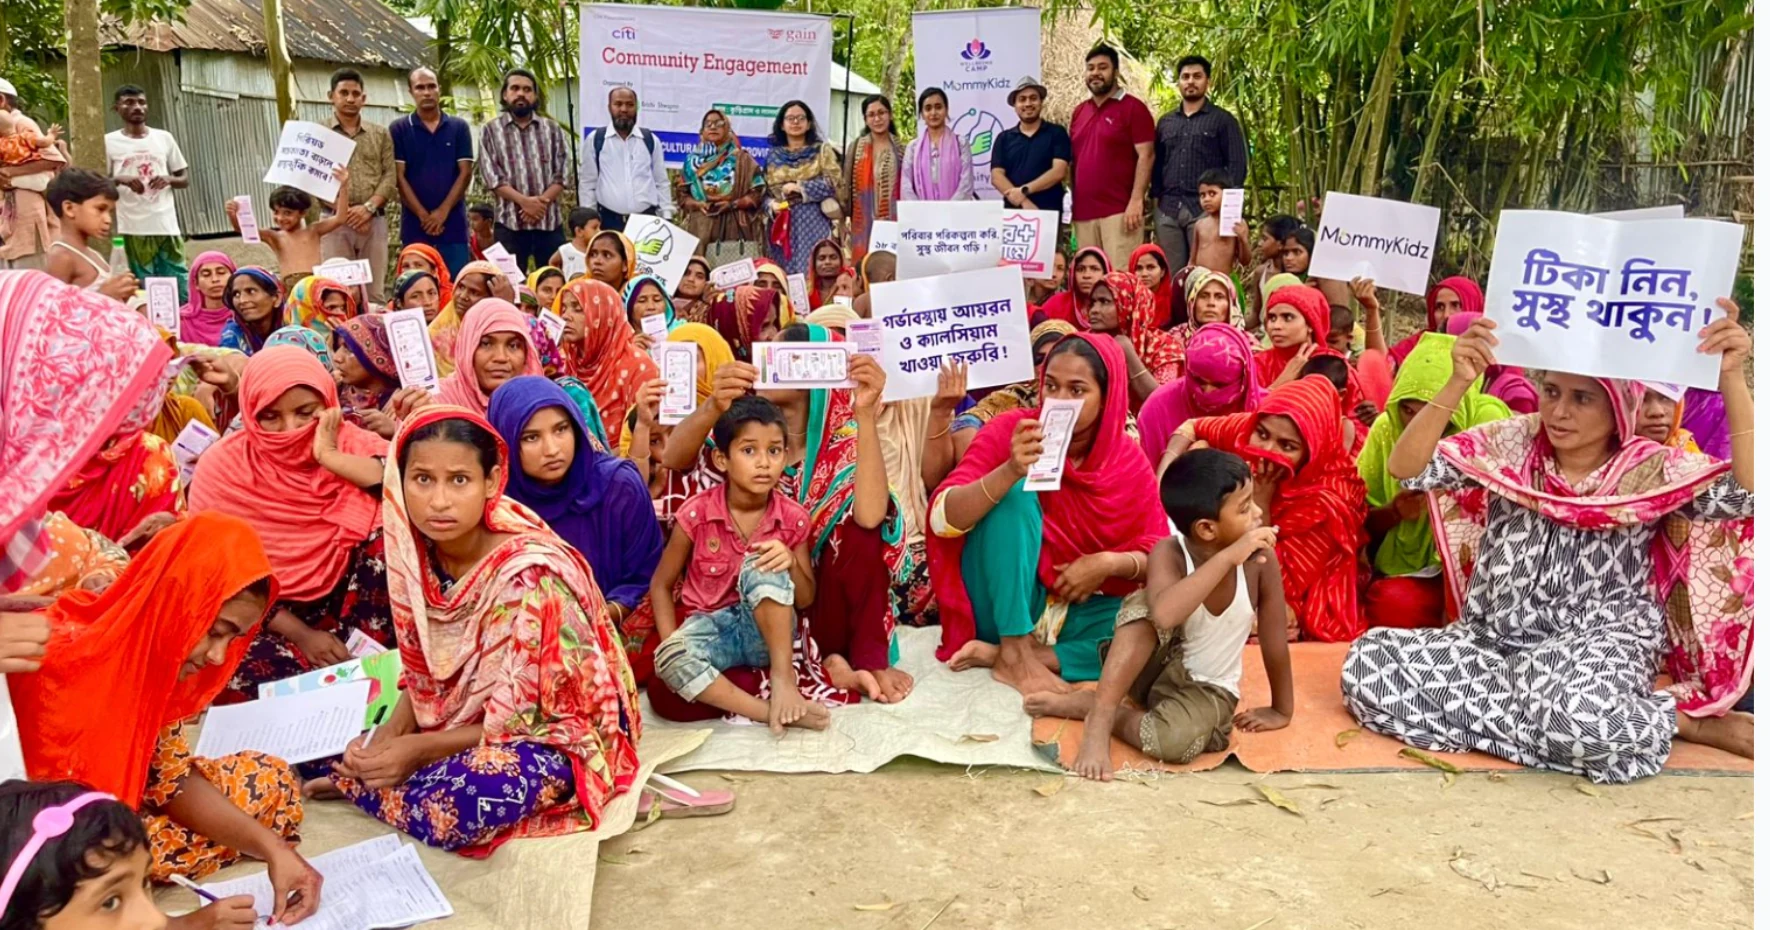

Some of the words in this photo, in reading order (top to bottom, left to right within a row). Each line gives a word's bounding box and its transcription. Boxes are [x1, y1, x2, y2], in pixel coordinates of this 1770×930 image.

[612, 27, 635, 40] citi
[786, 28, 816, 43] gain
[602, 47, 698, 73] Community
[703, 53, 808, 76] Engagement
[943, 77, 1011, 91] MommyKidz
[661, 142, 697, 154] CULTURA
[901, 228, 933, 240] পরিবার
[1320, 226, 1429, 259] MommyKidz
[934, 240, 960, 252] জীবন
[1522, 248, 1610, 295] টিকা
[882, 308, 947, 329] গর্ভাবস্থায়
[951, 299, 1011, 318] আয়রন
[1512, 290, 1576, 332] সুস্থ
[900, 336, 912, 350] ও
[916, 323, 998, 348] ক্যালসিয়াম
[899, 355, 942, 373] খাওয়া
